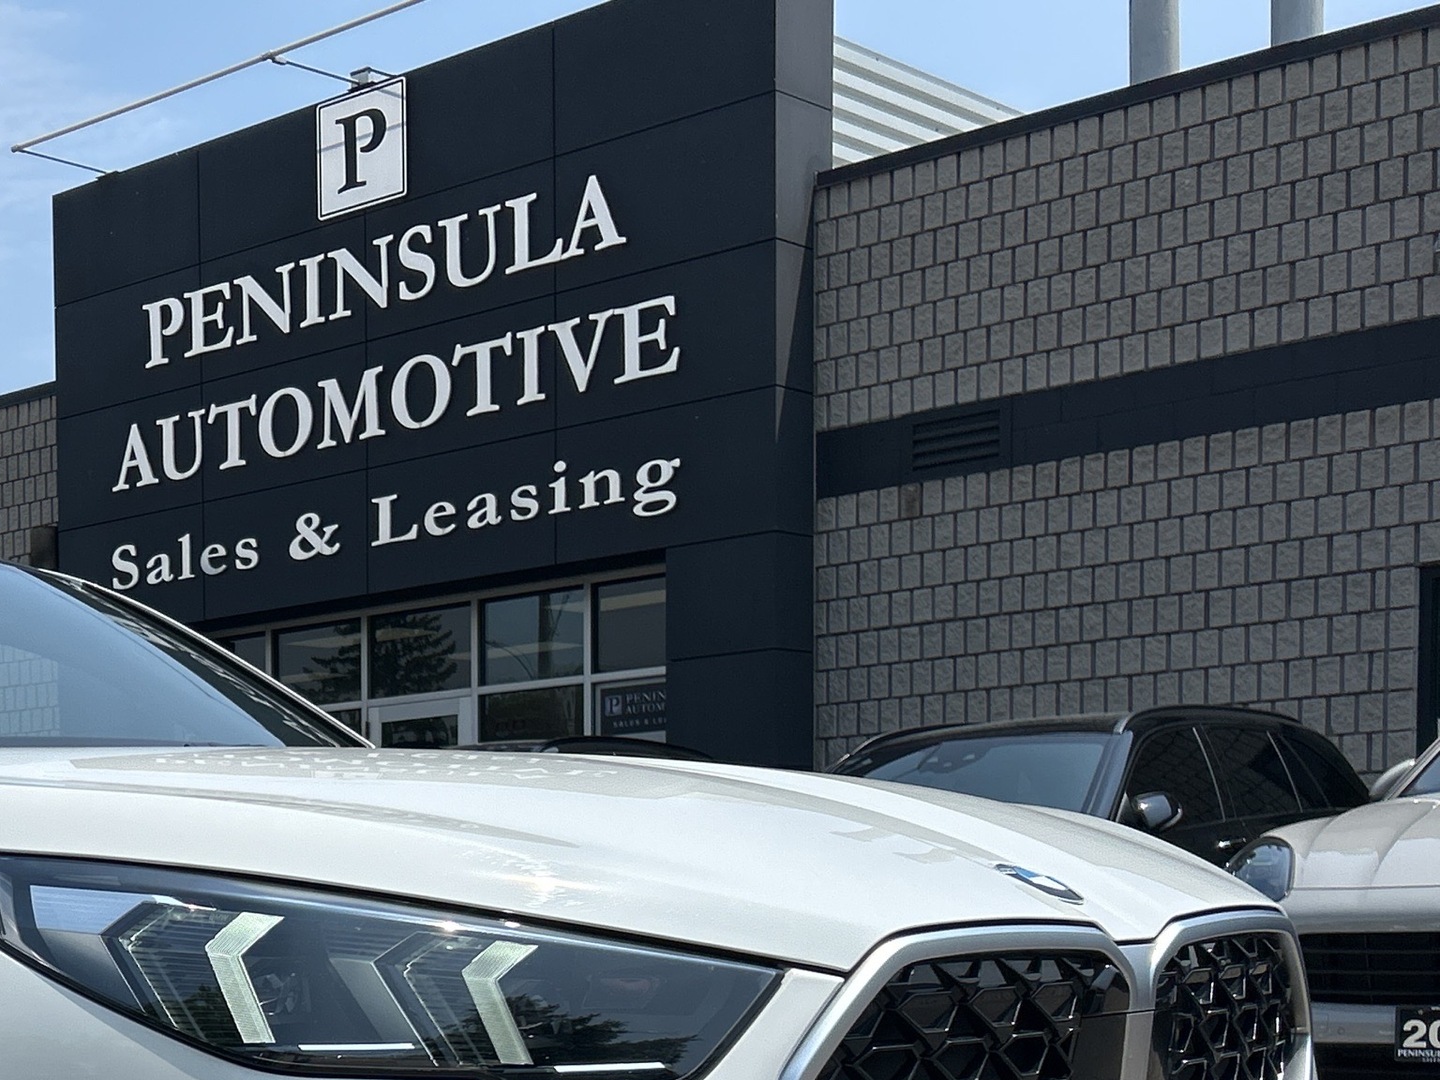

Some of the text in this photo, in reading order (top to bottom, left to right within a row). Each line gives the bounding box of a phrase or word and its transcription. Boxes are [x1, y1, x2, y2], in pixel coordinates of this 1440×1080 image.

[334, 107, 387, 195] P
[141, 174, 627, 369] PENINSULA
[111, 295, 681, 492] AUTOMOTIVE
[112, 457, 681, 590] Sales & Leasing
